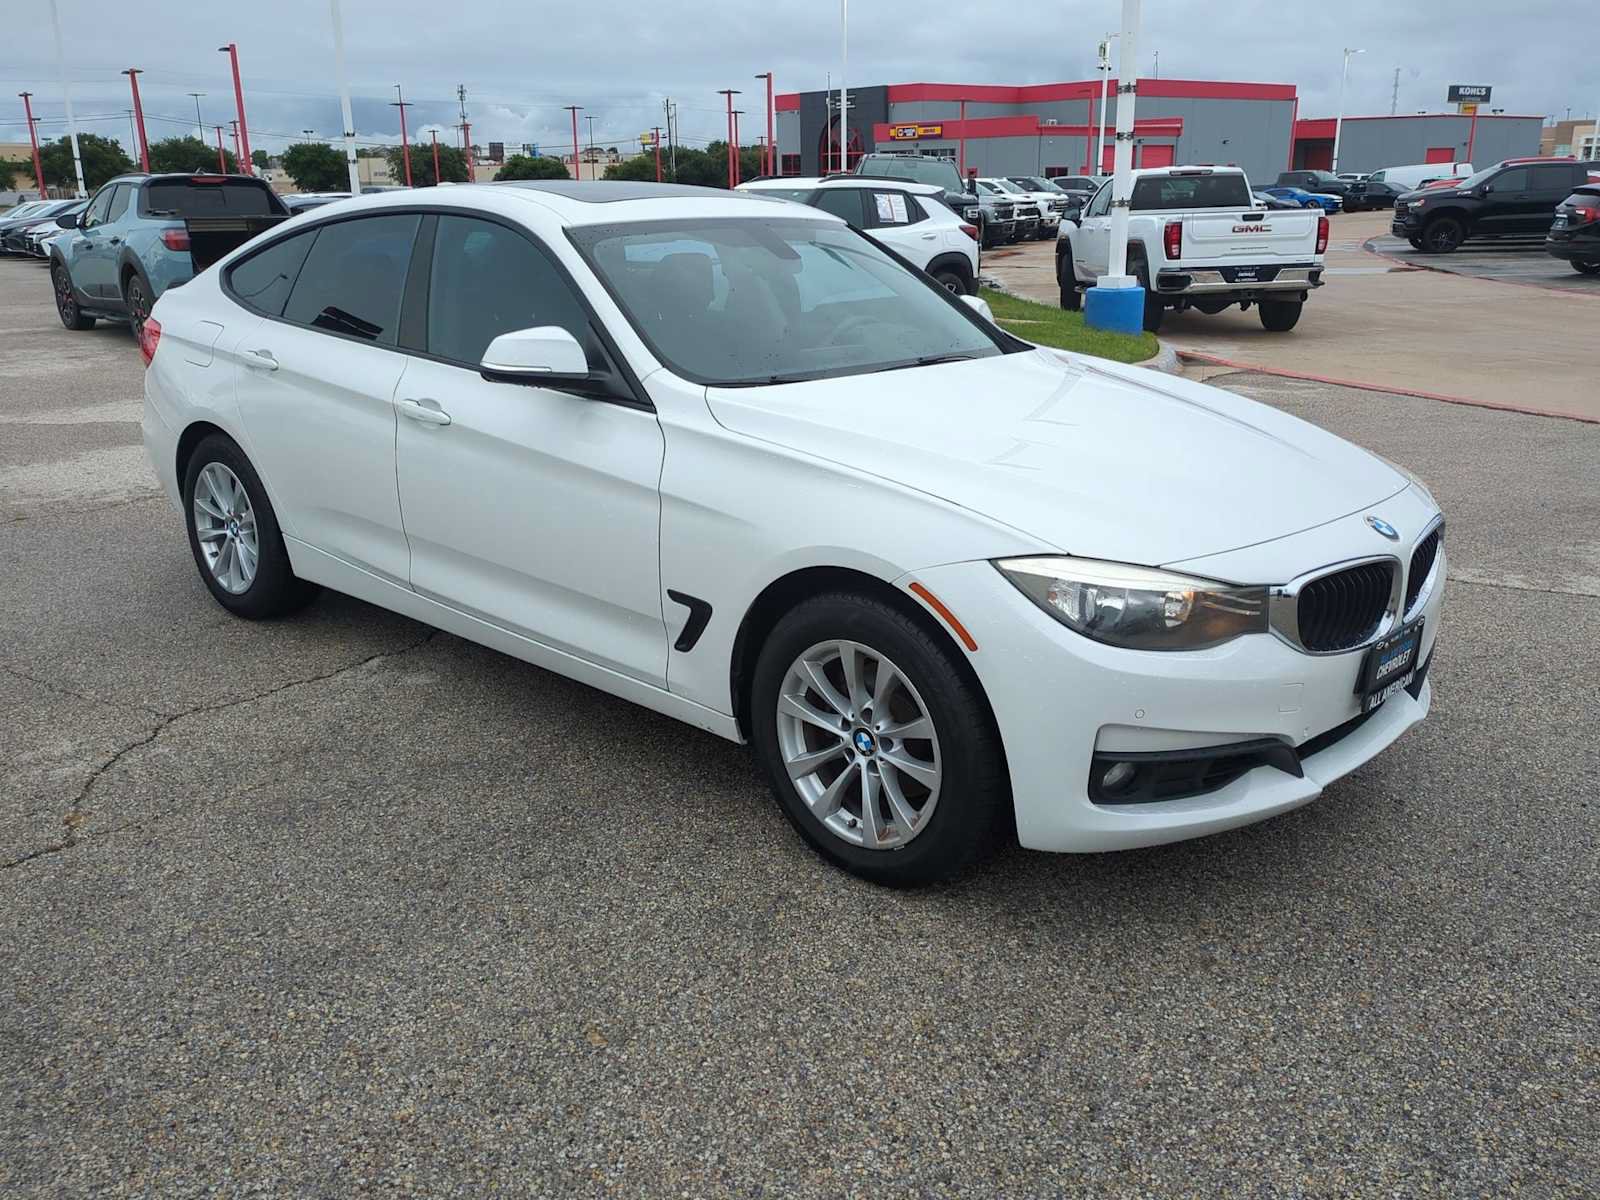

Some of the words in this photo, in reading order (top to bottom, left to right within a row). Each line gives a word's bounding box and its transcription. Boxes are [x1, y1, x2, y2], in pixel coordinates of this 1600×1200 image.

[1458, 87, 1487, 96] KOHL'S
[1232, 224, 1273, 233] GMC
[1376, 648, 1412, 680] CHEVROLET
[1369, 692, 1383, 711] ALL
